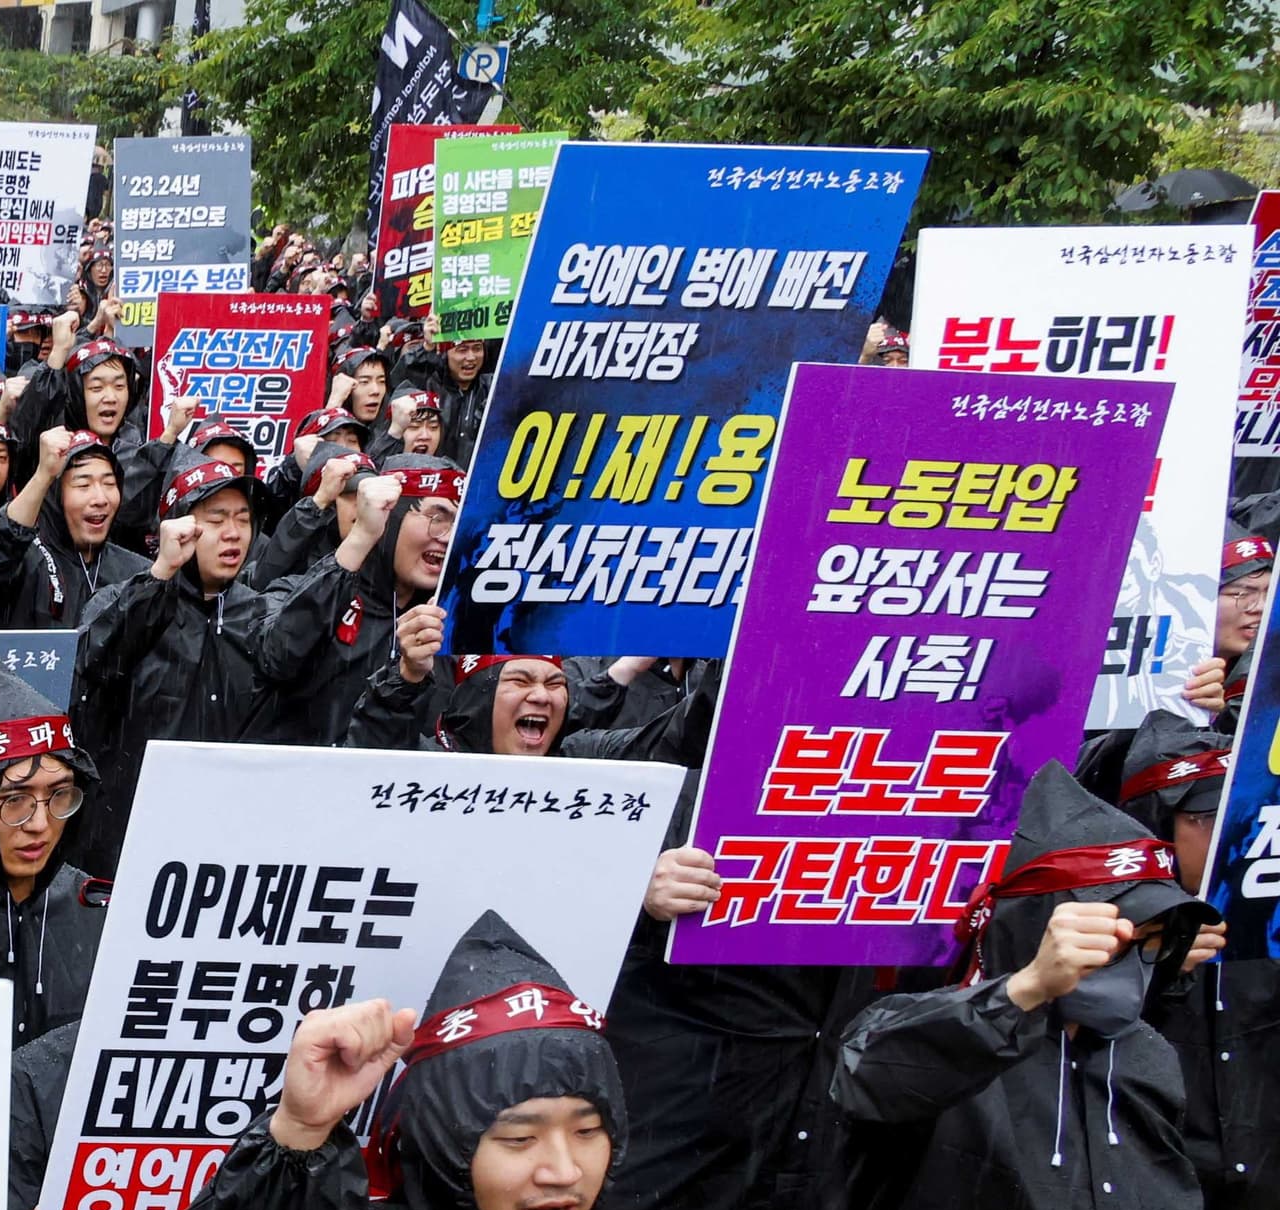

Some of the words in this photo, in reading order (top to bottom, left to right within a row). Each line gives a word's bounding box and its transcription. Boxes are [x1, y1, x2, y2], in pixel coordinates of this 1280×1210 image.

[476, 53, 492, 77] P
[443, 172, 459, 193] 이
[464, 168, 513, 192] 사단을
[707, 167, 905, 195] 전국삼성전자노동조합
[29, 200, 54, 219] 에서
[121, 206, 226, 229] 병합조건으로
[443, 192, 508, 215] 경영진은
[53, 225, 78, 244] 으로
[441, 219, 504, 247] 성과금
[121, 239, 175, 262] 약속한
[441, 254, 490, 276] 직원은
[1059, 242, 1237, 267] 전국삼성전자노동조합
[121, 269, 200, 293] 휴가일수
[205, 267, 245, 290] 보상
[441, 277, 473, 299] 알수
[478, 275, 511, 295] 없는
[550, 244, 687, 307] 연예인
[684, 246, 775, 311] 병에
[770, 250, 867, 312] 빠진
[171, 328, 313, 370] 삼성전자
[527, 321, 699, 381] 바지회장
[937, 314, 1176, 373] 분노하라!
[185, 373, 290, 414] 직원은
[950, 392, 1153, 428] 전국삼성전자노동조합
[826, 457, 1076, 532] 노동탄압
[806, 543, 1048, 619] 앞장서는
[840, 634, 993, 701] 사측!
[756, 726, 1012, 817] 분노로
[370, 782, 649, 820] 전국삼성전자노동조합
[145, 861, 417, 949] OPI제도는
[120, 960, 355, 1043] 불투명한
